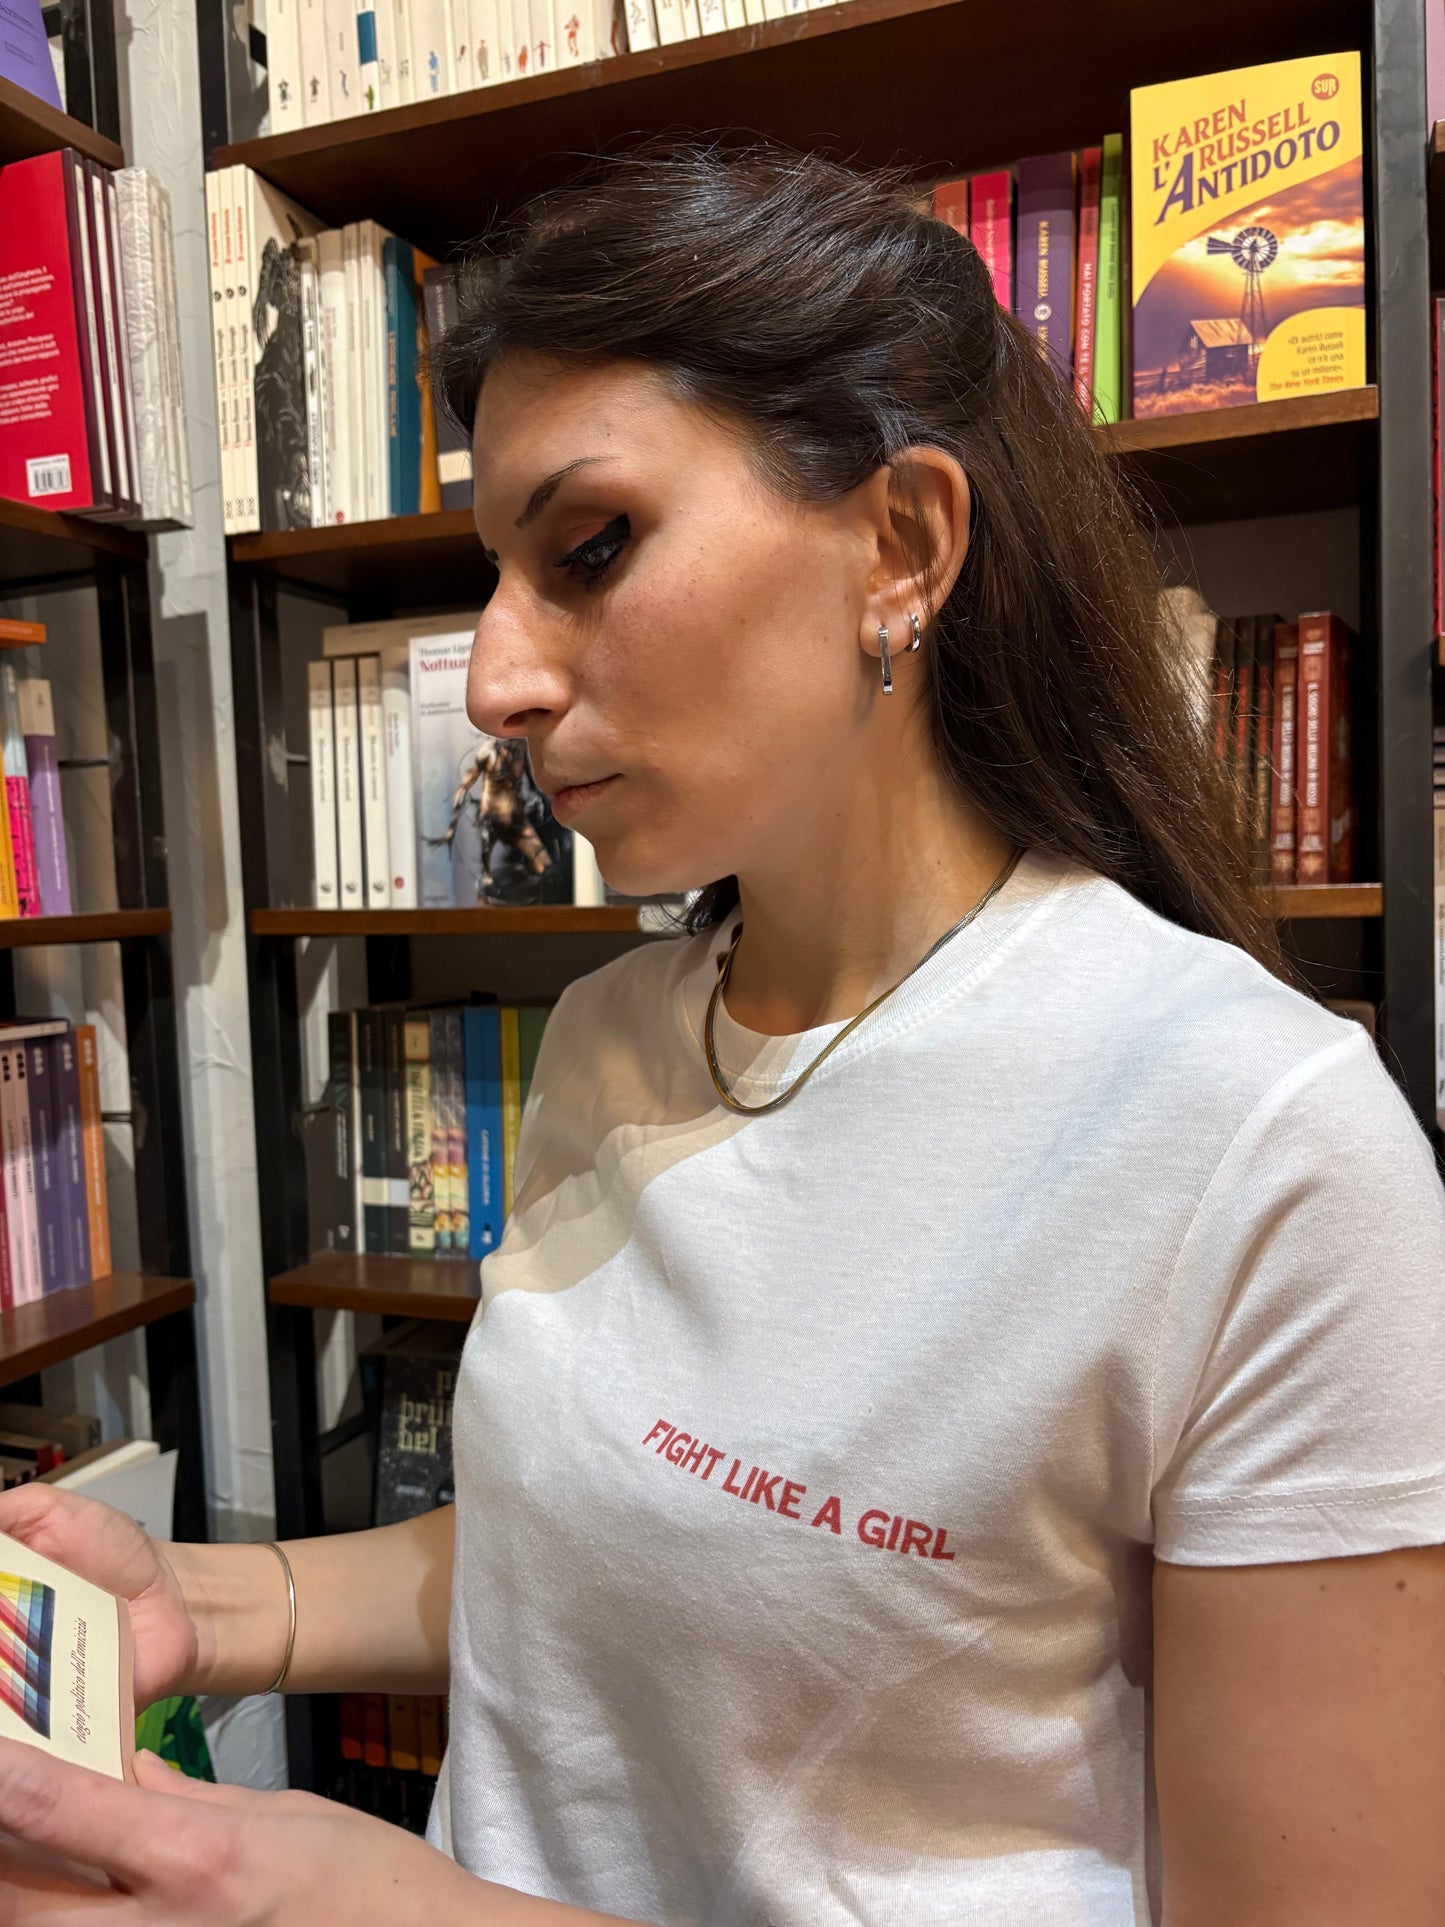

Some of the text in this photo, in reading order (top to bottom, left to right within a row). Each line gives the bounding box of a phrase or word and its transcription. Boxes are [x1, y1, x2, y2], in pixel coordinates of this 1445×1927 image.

[1314, 78, 1337, 97] SUR
[1152, 99, 1247, 164] KAREN
[1199, 101, 1311, 172] RUSSELL
[1153, 120, 1341, 226] L'ANTIDOTO
[1296, 341, 1343, 354] Karen Russell
[642, 1419, 956, 1561] FIGHT LIKE A GIRL
[70, 1617, 91, 1744] elogio politico dell'amicizia
